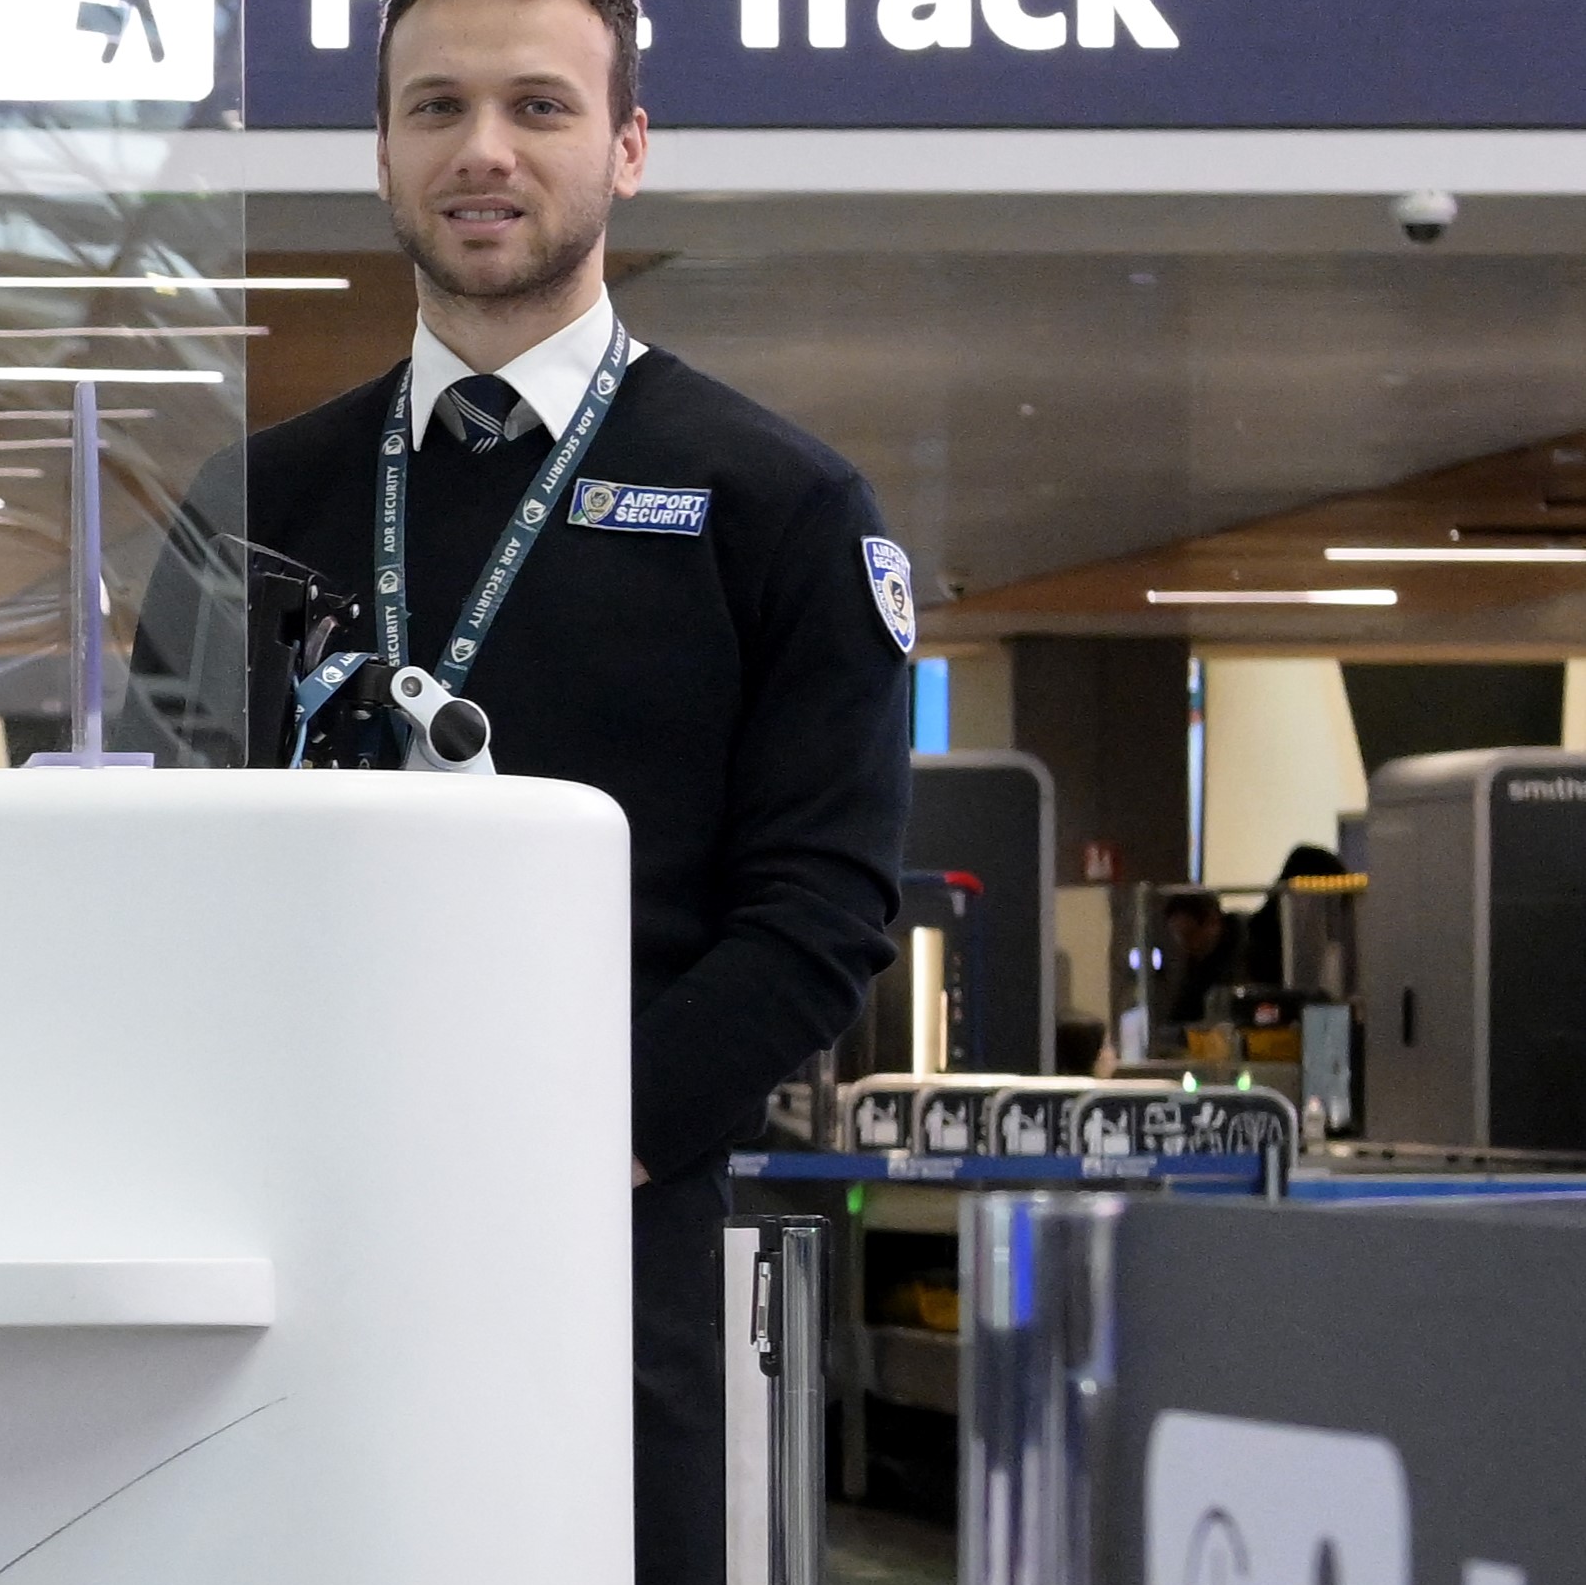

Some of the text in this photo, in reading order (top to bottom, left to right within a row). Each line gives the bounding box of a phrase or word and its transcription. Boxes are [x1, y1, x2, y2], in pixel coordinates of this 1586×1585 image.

[540, 406, 596, 495] ADR SECURITY
[384, 465, 401, 554] ADR SECURITY
[614, 507, 702, 527] SECURITY
[620, 491, 705, 511] AIRPORT
[469, 536, 522, 630] ADR SECURITY
[385, 604, 401, 667] SECURITY
